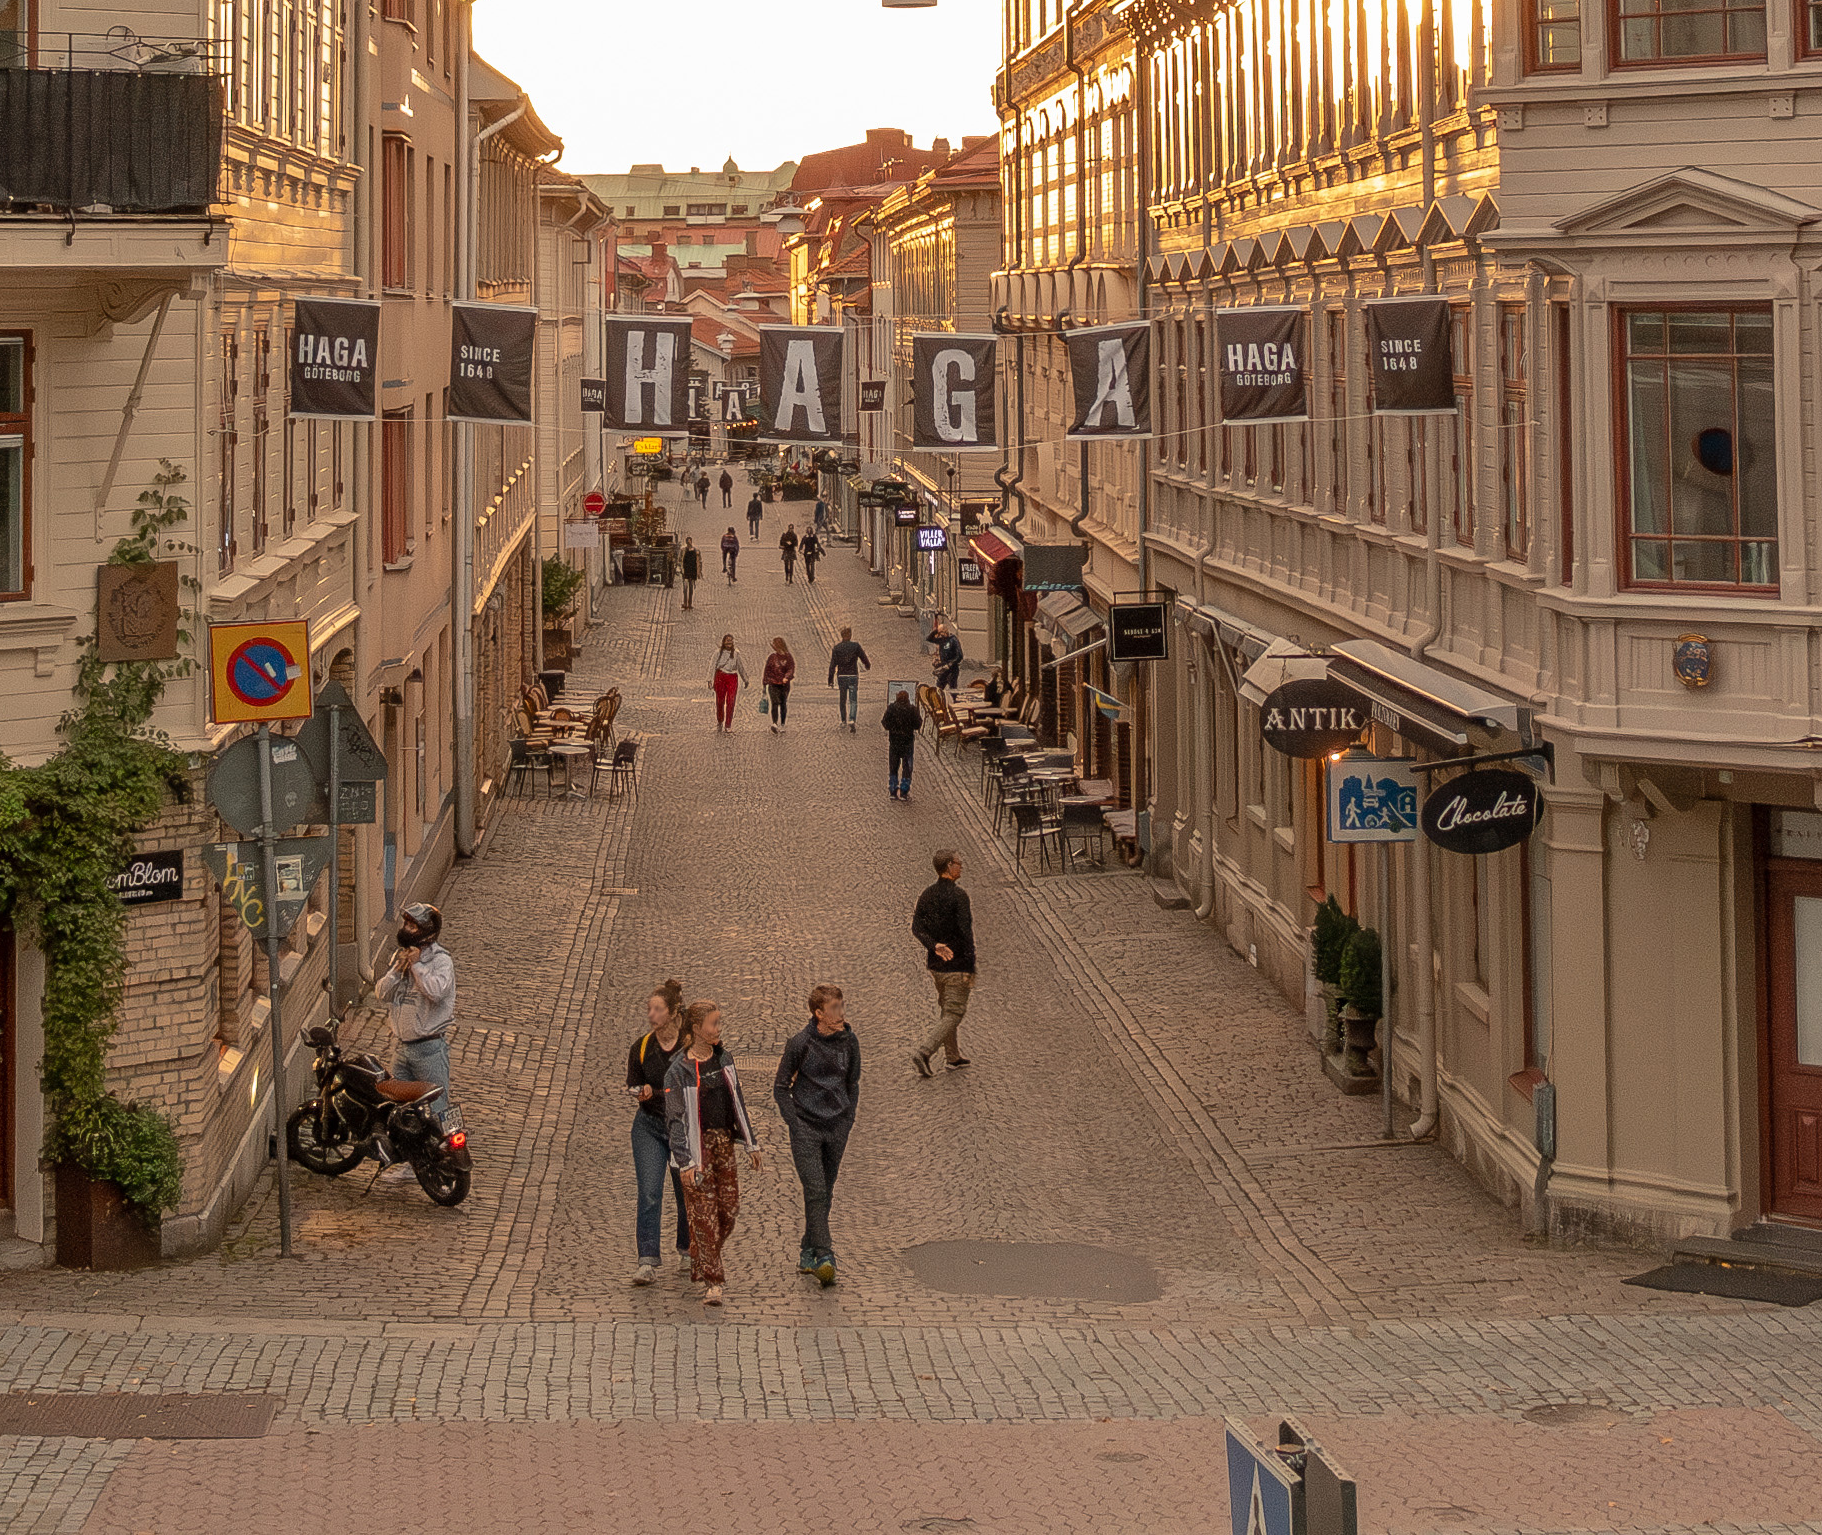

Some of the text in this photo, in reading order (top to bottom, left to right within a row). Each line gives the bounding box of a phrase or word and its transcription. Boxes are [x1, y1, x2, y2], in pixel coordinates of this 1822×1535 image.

[298, 333, 368, 368] HAGA
[460, 344, 501, 363] SINCE
[1380, 339, 1422, 354] SINCE
[1226, 342, 1297, 372] HAGA
[1382, 356, 1418, 371] 1648
[304, 364, 361, 383] GÖTEBORG
[459, 362, 493, 379] 1648
[1236, 371, 1292, 387] GÖTEBORG
[624, 329, 1137, 443] H A G A
[1264, 707, 1360, 731] ANTIK
[1436, 790, 1528, 831] Chocolate
